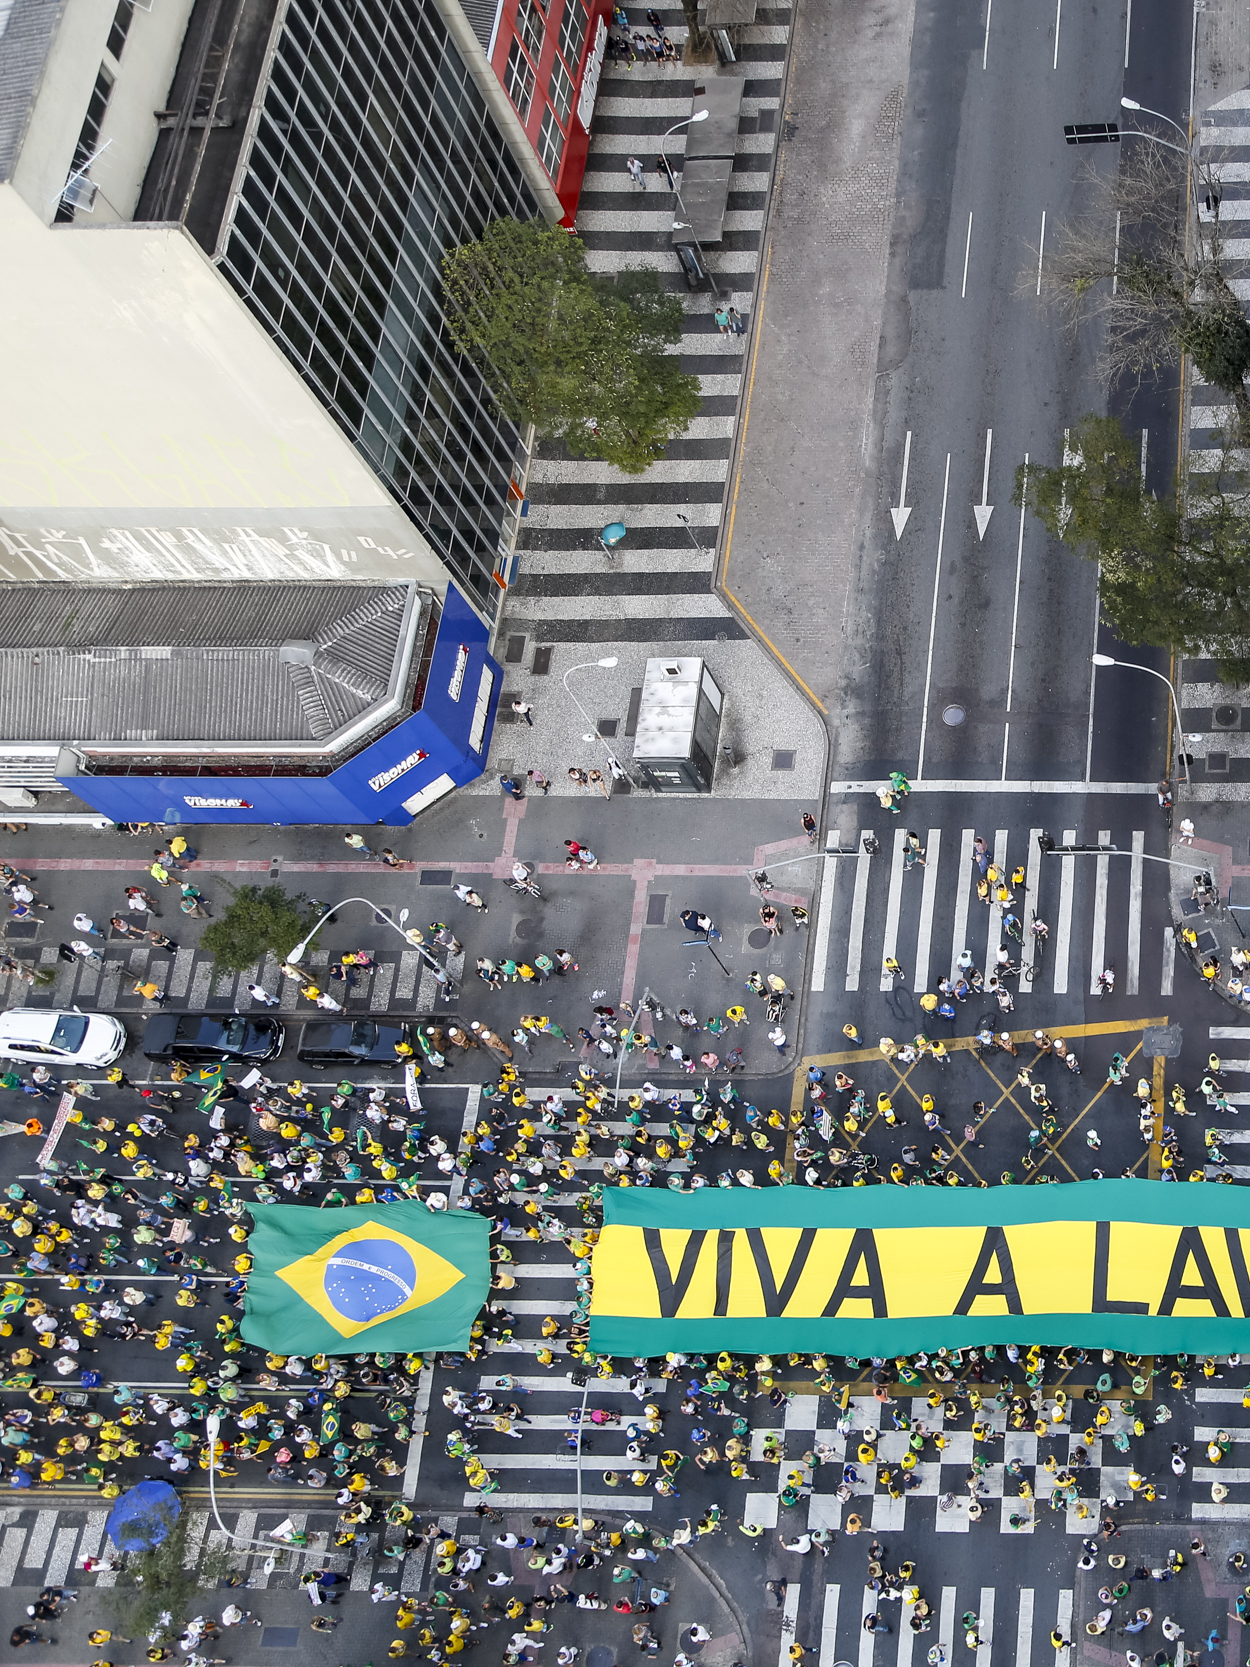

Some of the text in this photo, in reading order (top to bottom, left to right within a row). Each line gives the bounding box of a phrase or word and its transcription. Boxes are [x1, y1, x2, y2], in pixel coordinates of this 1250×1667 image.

[369, 749, 430, 793] VISOMAX
[341, 1259, 364, 1268] ORDEM
[375, 1267, 407, 1290] PROGRESSO
[642, 1227, 889, 1319] VIVA
[952, 1226, 1024, 1317] A
